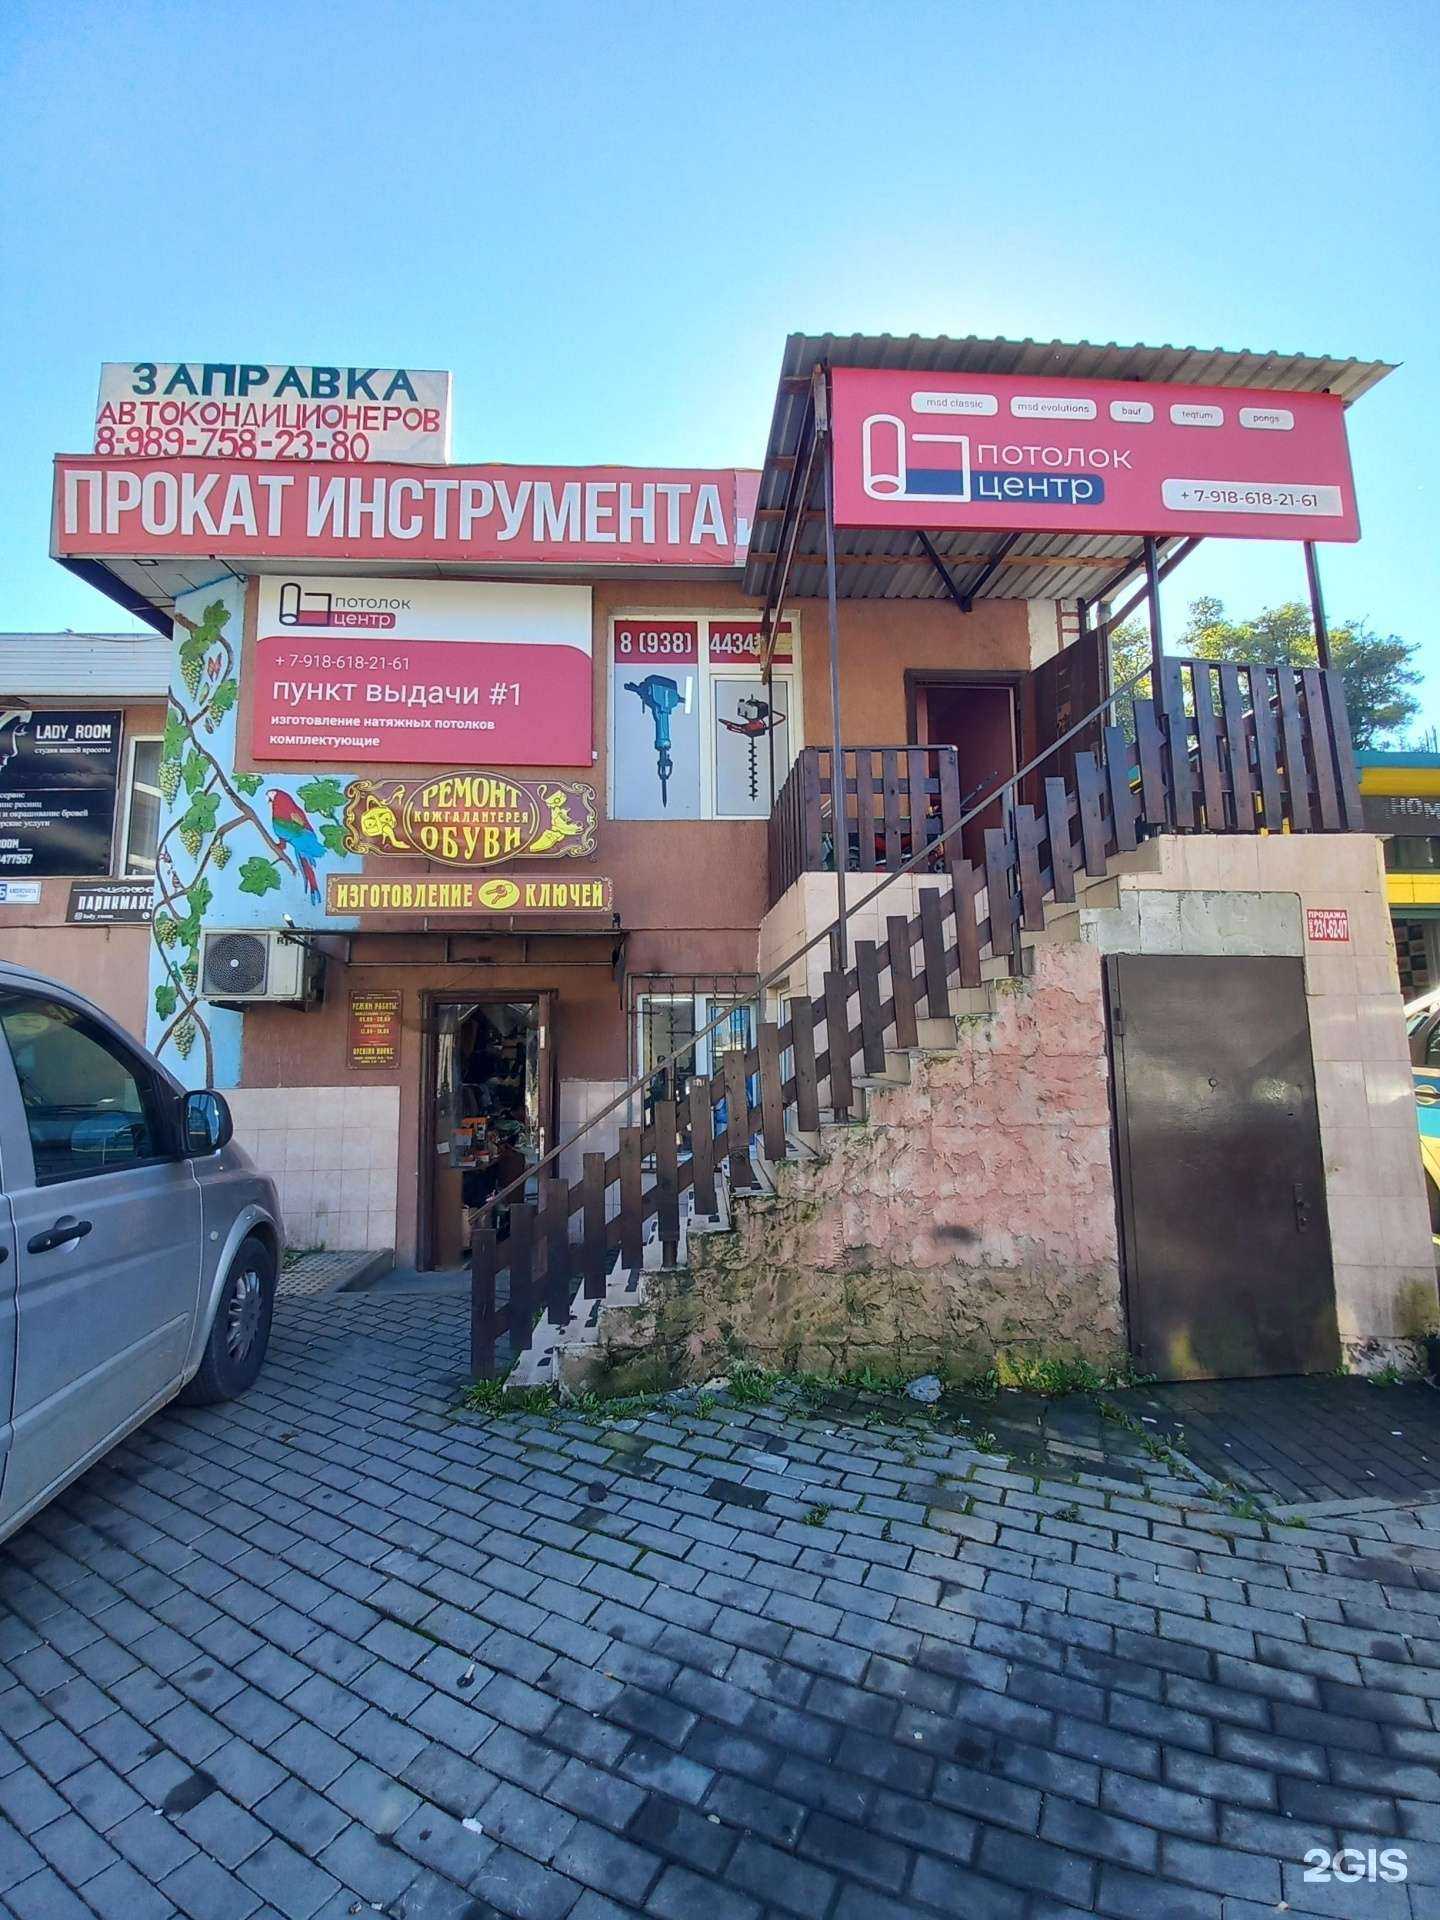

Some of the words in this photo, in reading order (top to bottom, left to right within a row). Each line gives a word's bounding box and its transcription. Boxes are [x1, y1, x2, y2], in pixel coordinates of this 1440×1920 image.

[132, 362, 418, 401] ЗАПРАВКА
[926, 397, 948, 408] msd
[950, 399, 983, 409] classic
[1017, 402, 1039, 412] msd
[1041, 403, 1090, 414] evolutions
[1122, 407, 1142, 416] bauf
[96, 401, 441, 432] АВТОКОНДИЦИОНЕРОВ
[1253, 413, 1280, 424] pongs
[95, 427, 370, 462] 8-989-758-23-80
[978, 444, 1133, 470] потолок
[978, 475, 1094, 505] центр
[64, 469, 294, 537] ПРОКАТ
[307, 475, 728, 546] ИНСТРУМЕНТА
[334, 595, 412, 611] потолок
[333, 612, 392, 630] центр
[620, 632, 632, 654] 8
[639, 632, 692, 654] (938)
[272, 681, 357, 706] пункт
[367, 683, 479, 708] выдачи
[489, 682, 521, 706] #1
[271, 715, 361, 727] изготовление
[364, 717, 431, 729] натяжных
[434, 719, 496, 731] потолков
[269, 734, 380, 747] комплектующие
[422, 777, 522, 808] РЕМОНТ
[414, 811, 529, 824] КОЖГАЛАНТЕРЕЯ
[420, 826, 521, 860] ОБУВИ
[336, 883, 473, 908] ИЗГОТОВЛЕНИЕ
[525, 881, 603, 908] КЛЮЧЕЙ
[1308, 911, 1347, 920] ПРОДАЖА
